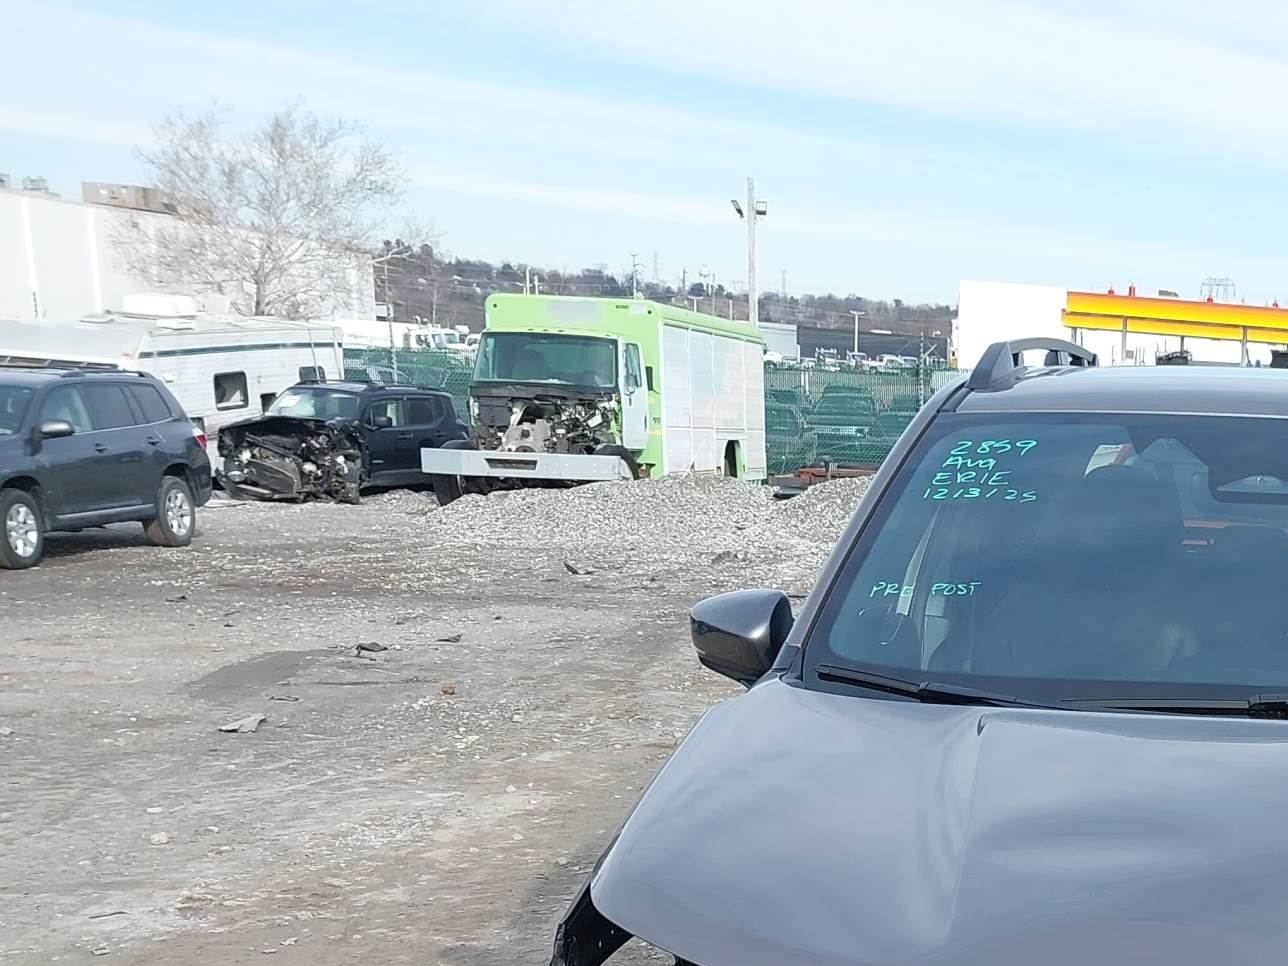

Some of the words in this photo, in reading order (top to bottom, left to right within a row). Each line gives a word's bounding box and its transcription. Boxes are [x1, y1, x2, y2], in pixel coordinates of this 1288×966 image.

[949, 439, 1038, 456] 2859
[931, 470, 1013, 485] ERIE
[869, 581, 915, 598] PRE
[931, 581, 982, 596] POST
